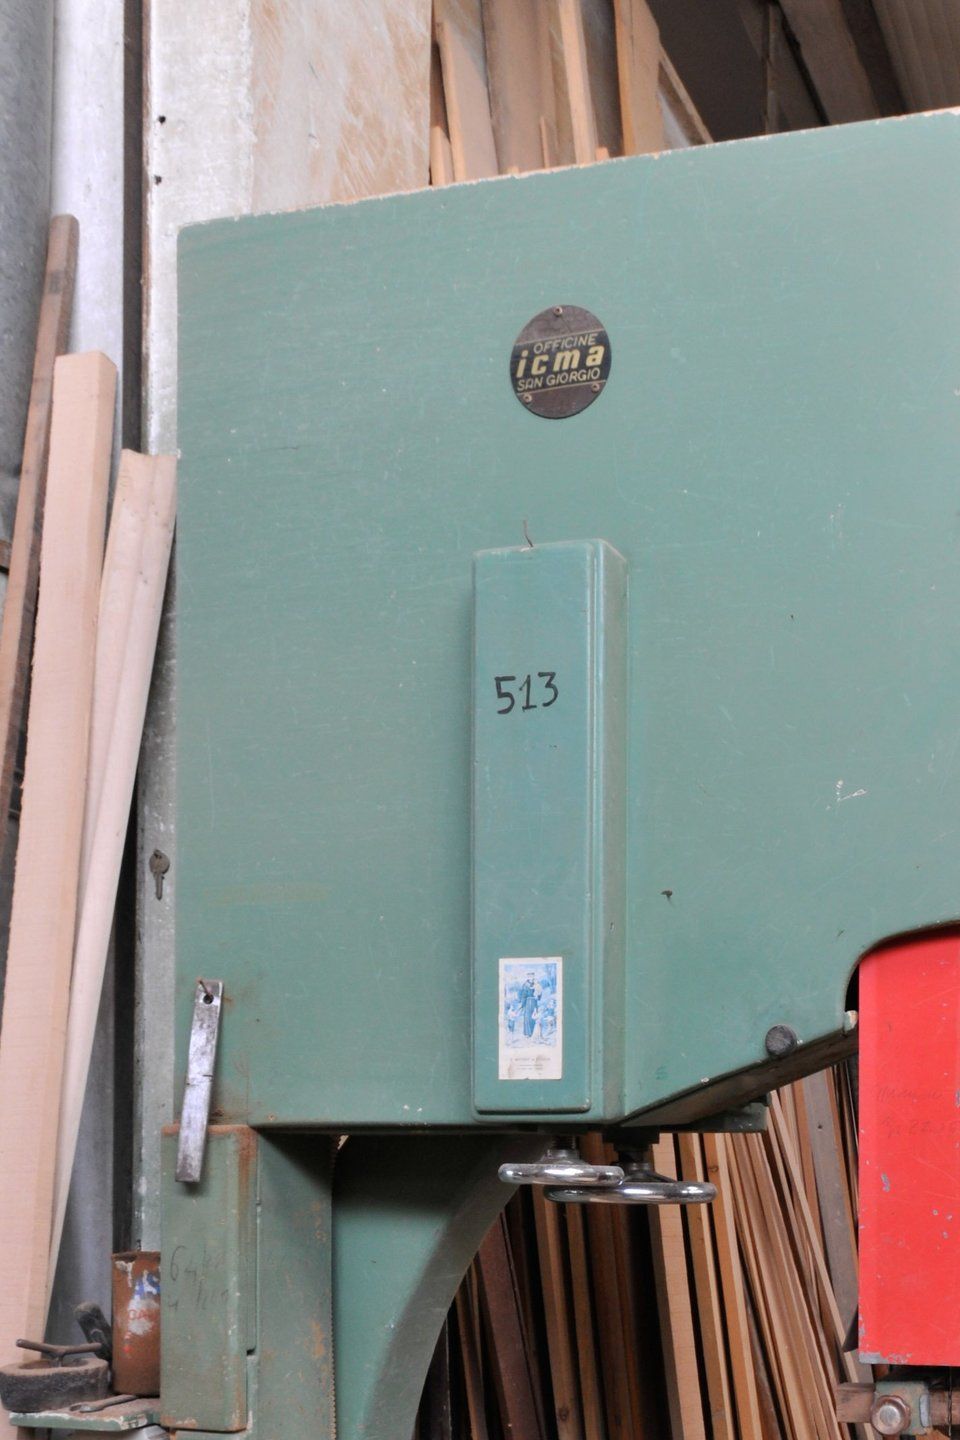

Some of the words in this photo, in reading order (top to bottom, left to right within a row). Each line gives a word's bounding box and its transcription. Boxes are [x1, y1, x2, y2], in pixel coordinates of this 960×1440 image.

[533, 333, 599, 354] OFFICINE
[516, 345, 605, 378] icma
[517, 377, 544, 391] SAN
[546, 367, 600, 386] GIORGIO
[494, 671, 559, 715] 513
